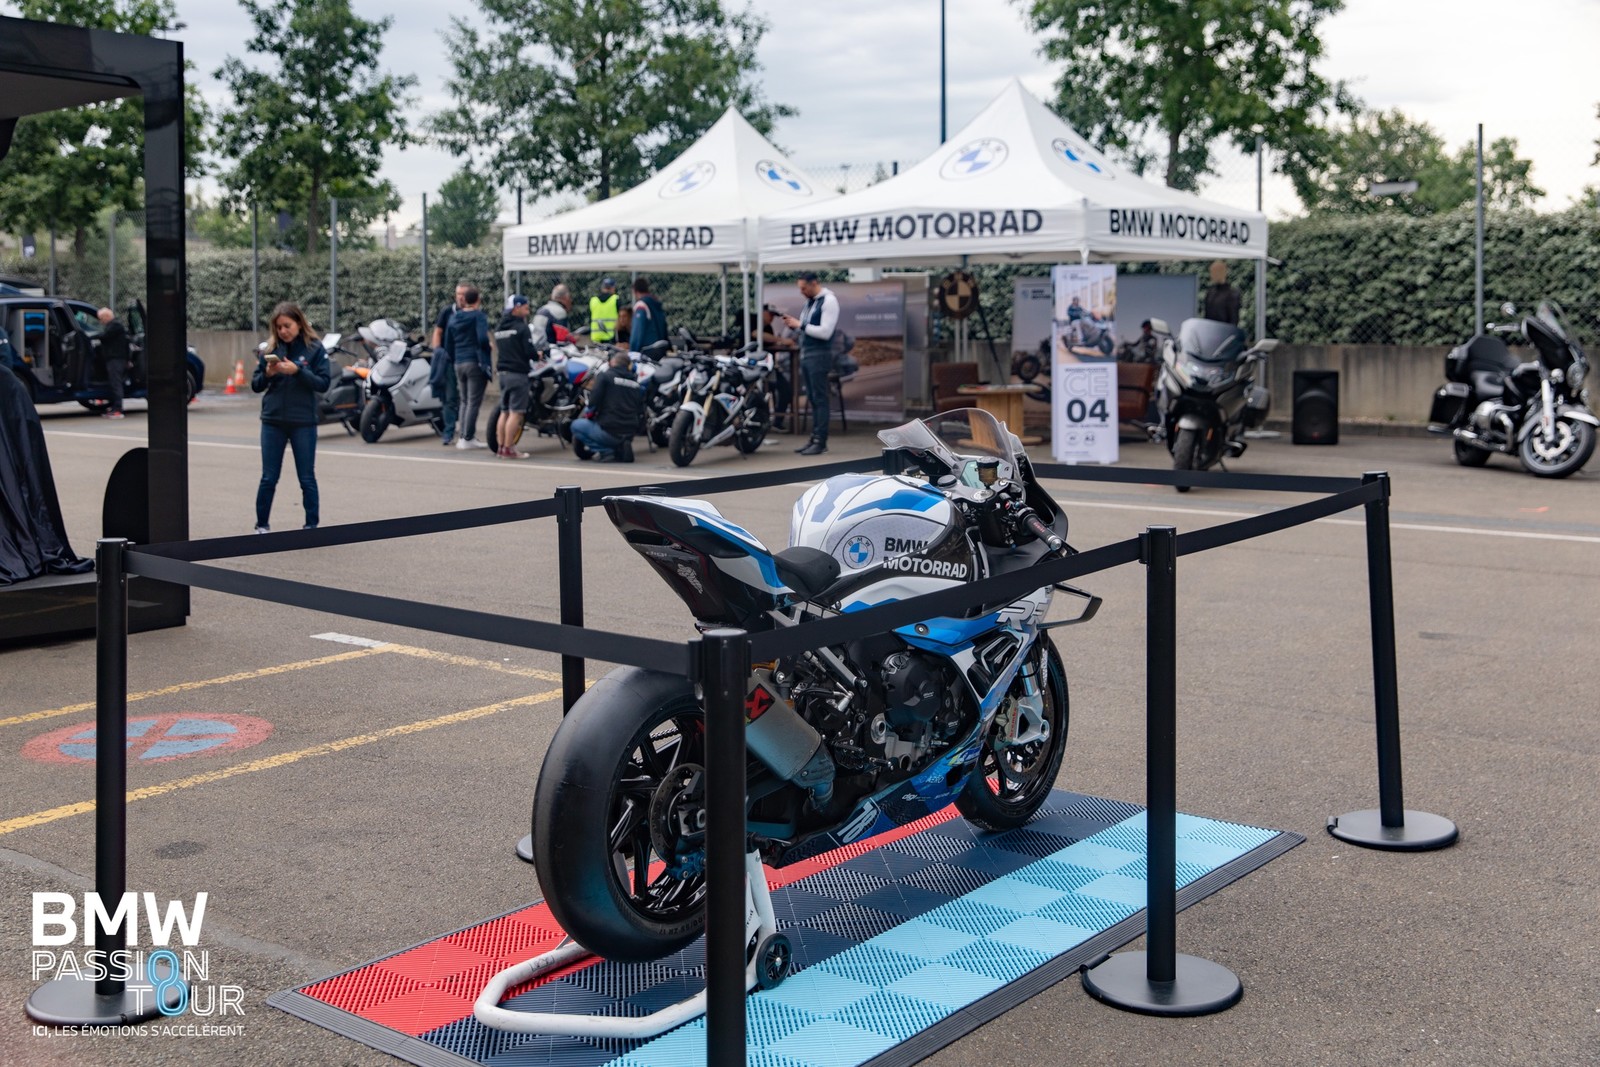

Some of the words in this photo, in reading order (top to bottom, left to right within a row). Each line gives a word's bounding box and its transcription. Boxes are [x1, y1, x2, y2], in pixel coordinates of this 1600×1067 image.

[528, 232, 579, 256] BMW
[586, 226, 714, 254] MOTORRAD
[791, 220, 860, 245] BMW
[869, 209, 1043, 242] MOTORRAD
[1110, 209, 1154, 237] BMW
[1160, 213, 1250, 245] MOTORRAD
[1063, 371, 1109, 397] CE
[1066, 398, 1110, 423] 04
[884, 536, 929, 555] BMW
[883, 556, 968, 579] MOTORRAD
[837, 801, 878, 844] 78
